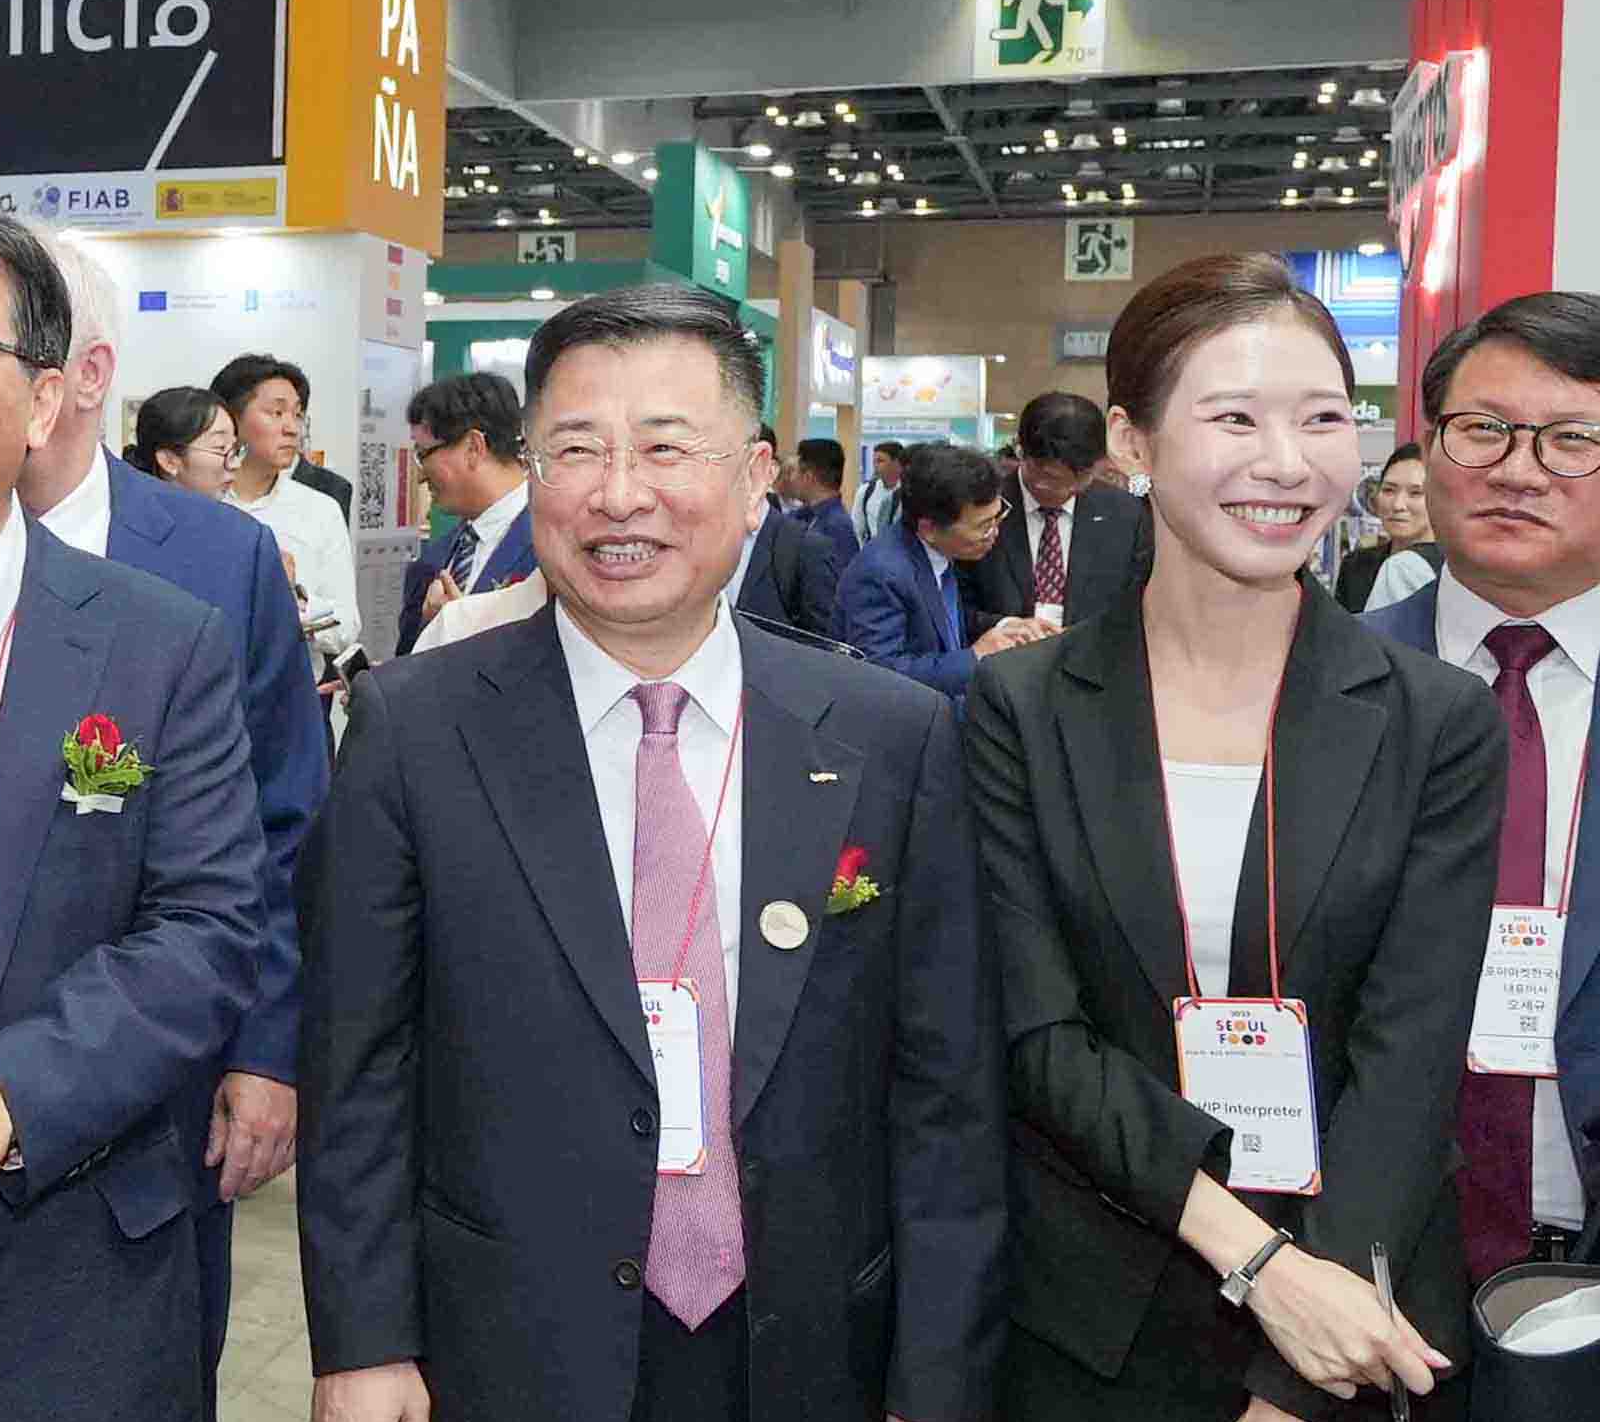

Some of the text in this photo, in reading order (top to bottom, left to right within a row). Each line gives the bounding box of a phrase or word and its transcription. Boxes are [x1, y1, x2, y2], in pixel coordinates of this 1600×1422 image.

[373, 75, 421, 198] ÑA
[67, 188, 131, 210] FIAB
[1497, 923, 1548, 936] SEOUL
[1215, 1019, 1269, 1033] SEOUL
